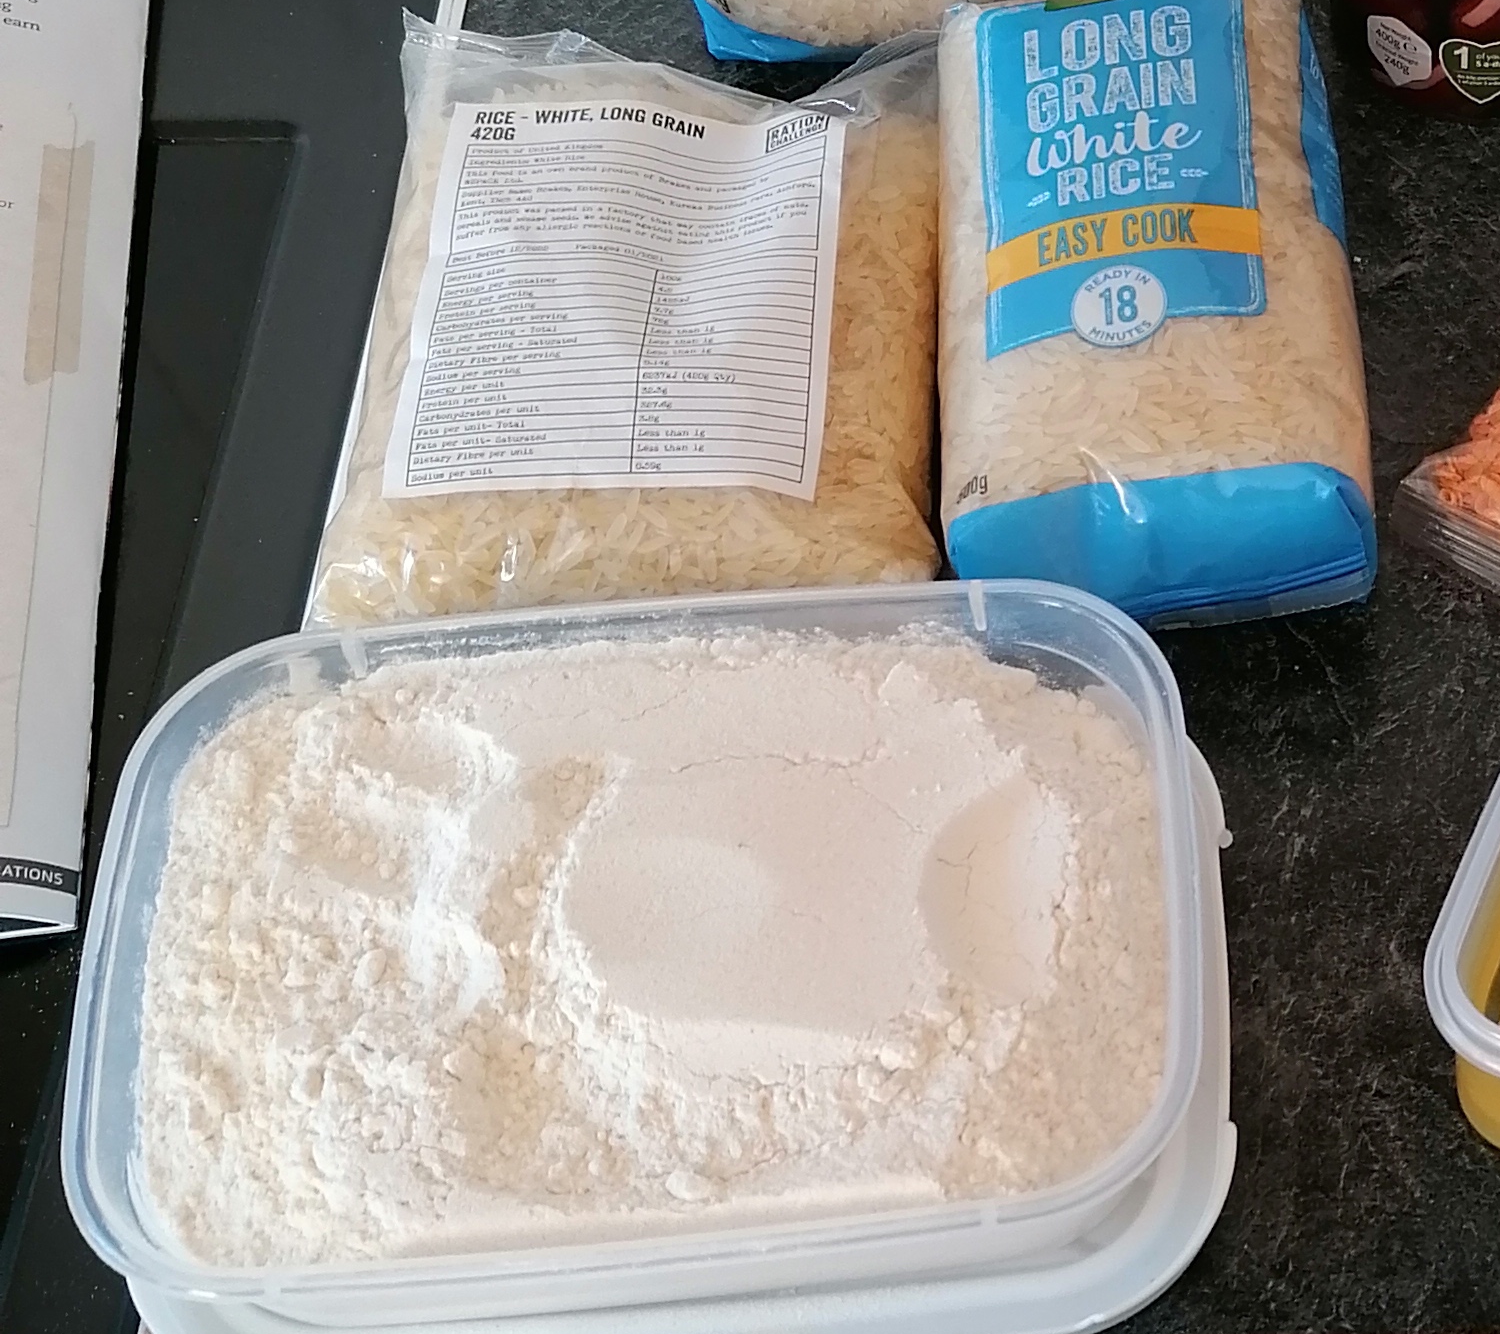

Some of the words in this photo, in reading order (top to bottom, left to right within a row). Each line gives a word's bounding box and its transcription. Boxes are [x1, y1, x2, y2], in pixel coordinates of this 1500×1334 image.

[3, 16, 41, 32] earn
[1023, 4, 1193, 84] LONG
[1453, 45, 1470, 70] 1
[1026, 58, 1197, 134] GRAIN
[470, 127, 516, 141] 420G
[474, 110, 517, 125] RICE
[535, 107, 594, 124] WHITE,
[600, 107, 647, 123] LONG
[652, 112, 706, 139] GRAIN
[771, 114, 827, 140] RATION
[770, 124, 824, 148] CHALLENGE
[1027, 110, 1203, 178] White
[1056, 153, 1176, 208] RICE
[1036, 220, 1104, 267] EASY
[1121, 208, 1199, 247] COOK
[1084, 269, 1132, 293] READY
[1134, 272, 1151, 285] IN
[1098, 284, 1138, 325] 18
[1088, 320, 1152, 341] MINUTES
[496, 420, 525, 429] Total
[1, 863, 64, 886] ATIONS
